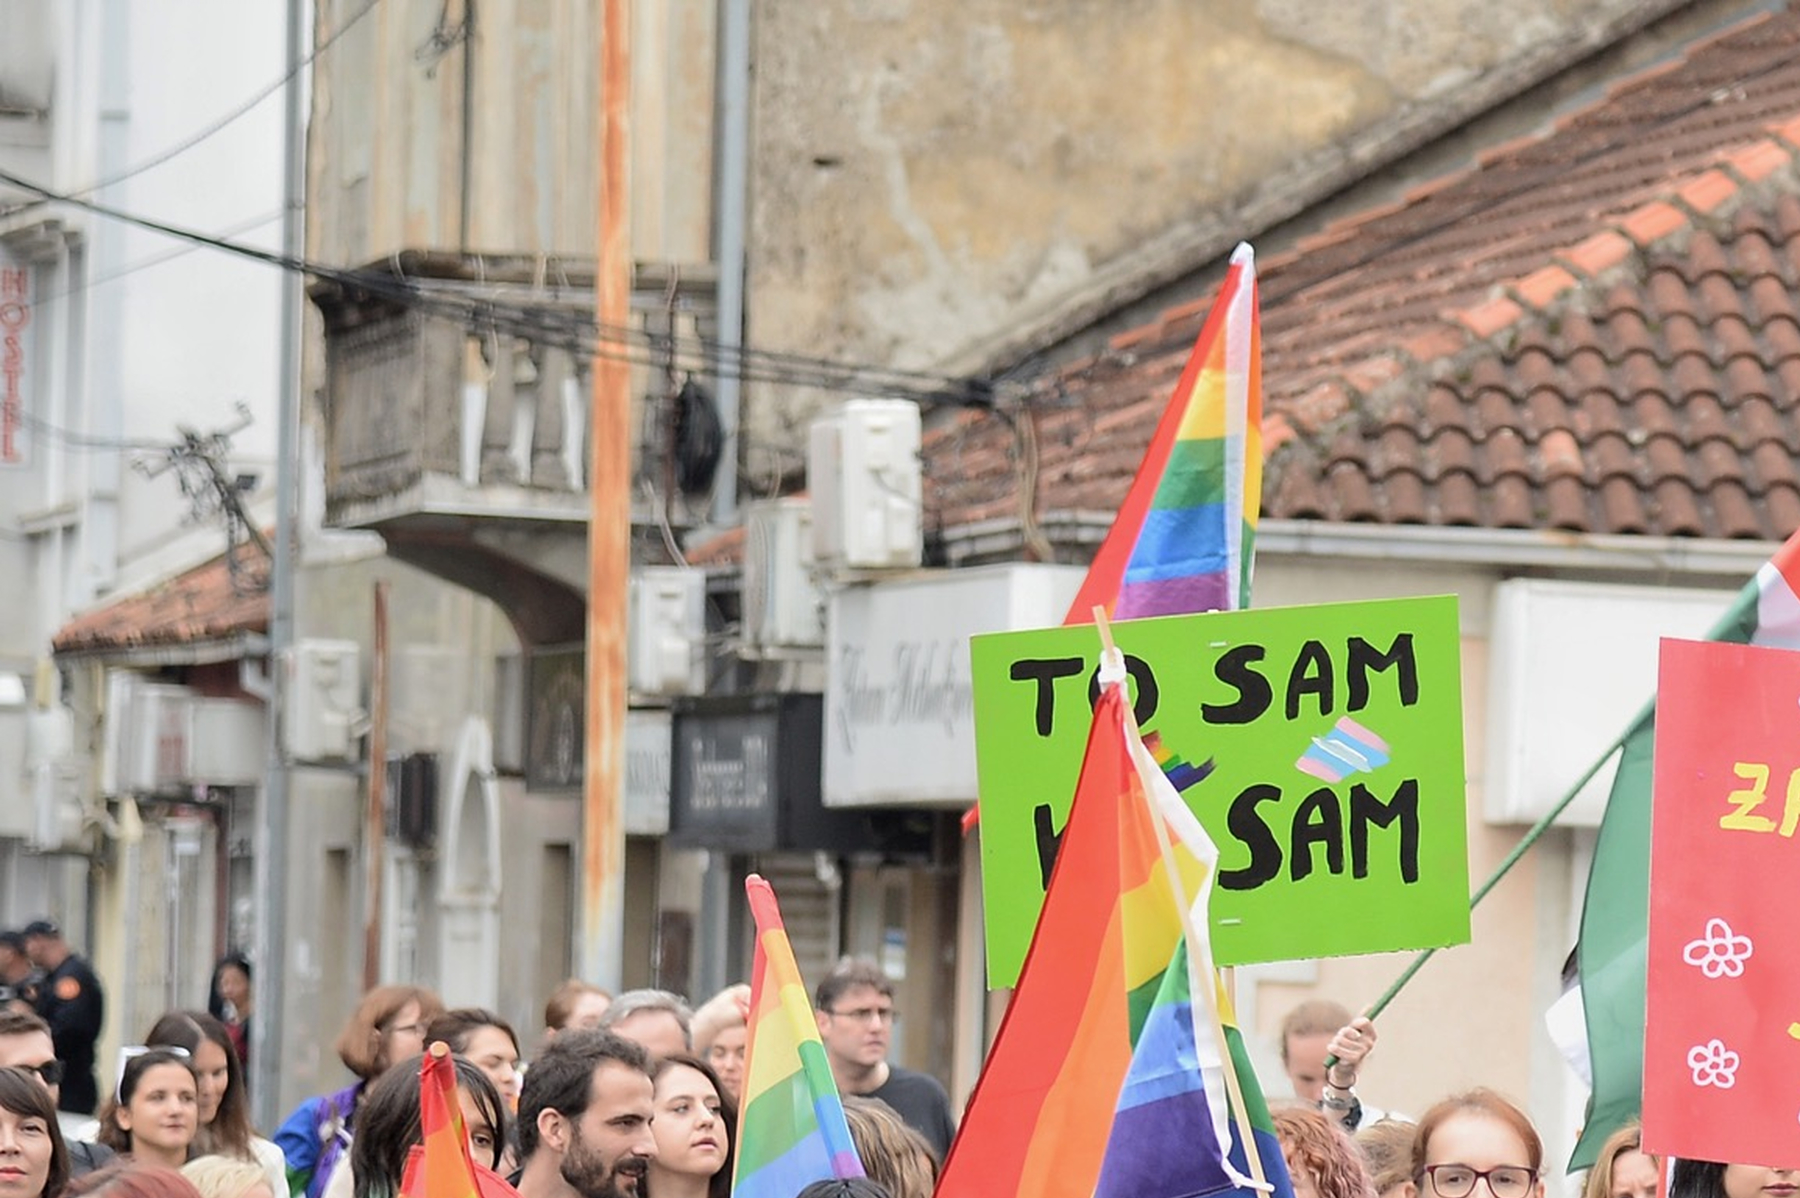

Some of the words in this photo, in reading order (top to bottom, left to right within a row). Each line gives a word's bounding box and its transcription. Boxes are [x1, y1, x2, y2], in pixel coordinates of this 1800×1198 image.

[1010, 654, 1160, 738] TO
[1200, 632, 1420, 726] SAM
[1217, 779, 1420, 892] SAM
